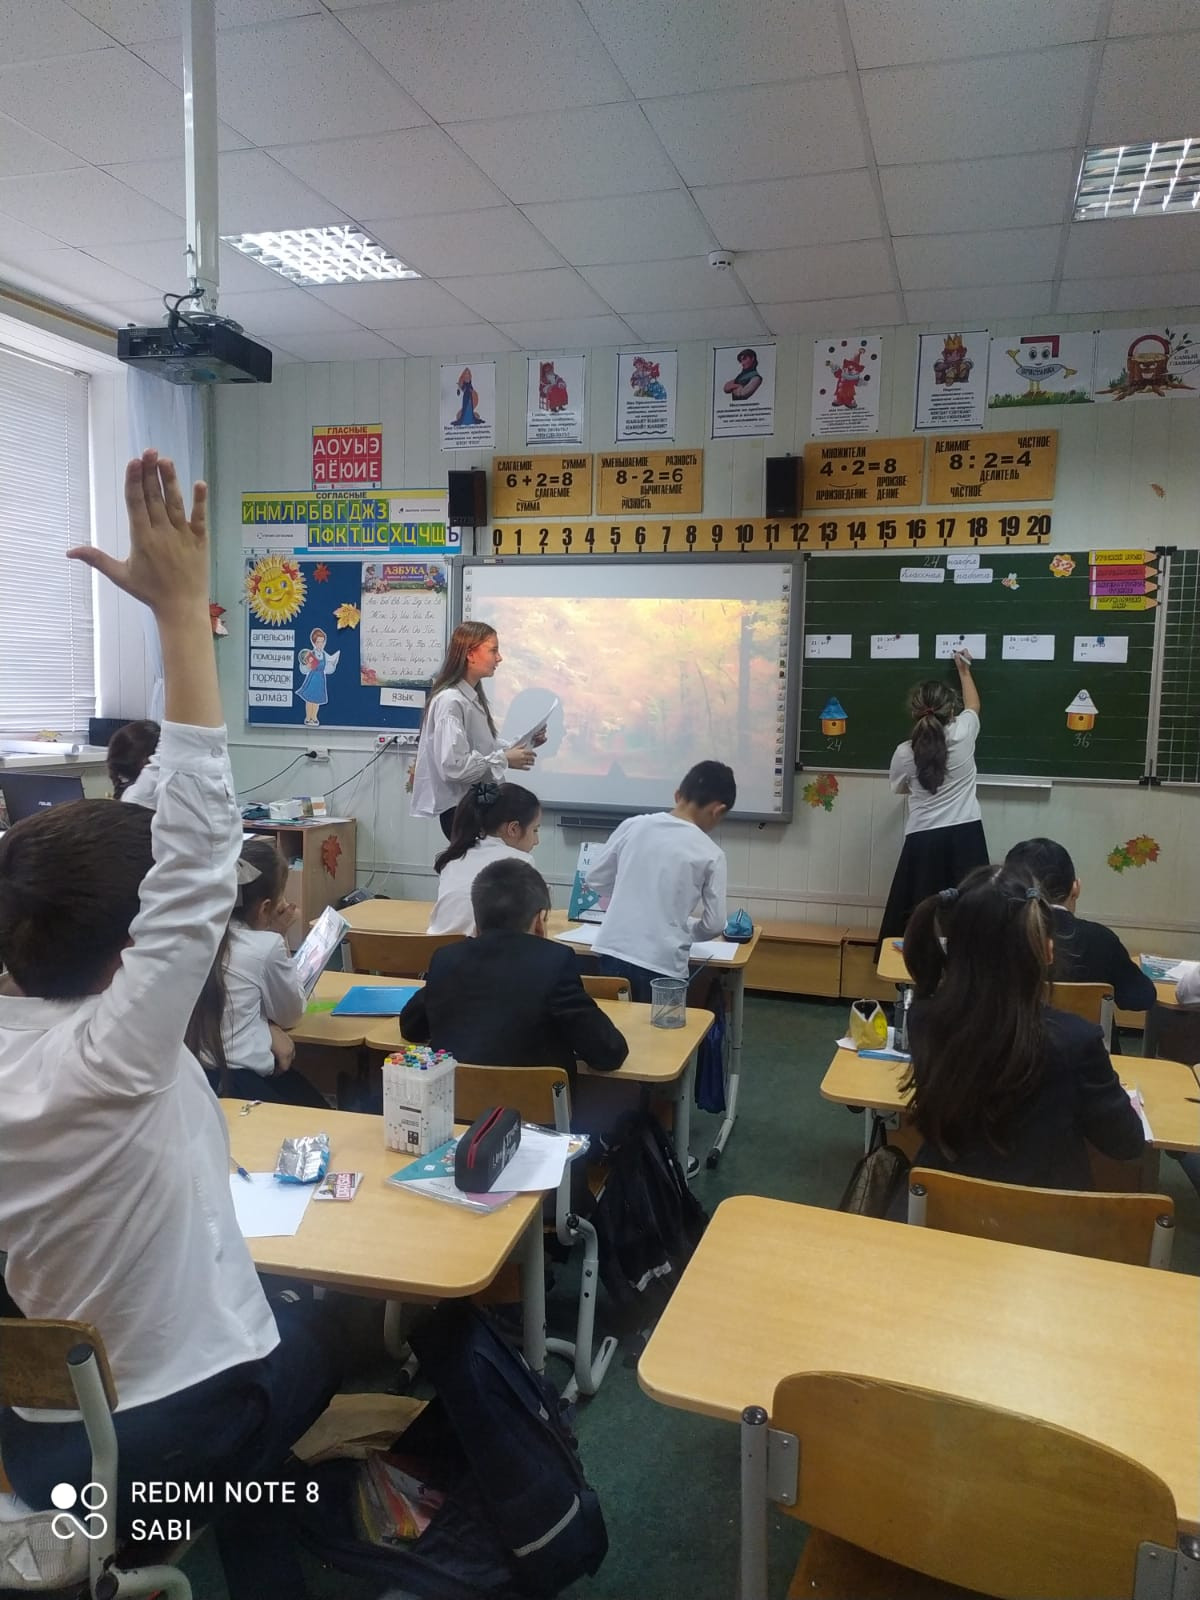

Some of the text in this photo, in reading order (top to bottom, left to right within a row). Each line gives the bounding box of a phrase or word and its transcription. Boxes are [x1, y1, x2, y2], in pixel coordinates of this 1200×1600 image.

[327, 426, 368, 435] ГЛАСНЫЕ
[935, 440, 971, 454] ДЕЛИМОЕ
[1018, 435, 1051, 449] ЧАСТНОЕ
[822, 447, 866, 459] МНОЖИТЕЛИ
[497, 461, 532, 471] СЛАГАЕМОЕ
[562, 459, 587, 469] СУММА
[601, 457, 648, 468] УМЕНЬШАЕМОЕ
[665, 455, 697, 466] РАЗНОСТЬ
[950, 454, 963, 470] 8
[506, 473, 517, 488] 6
[616, 470, 627, 484] 8
[979, 469, 1020, 482] ДЕЛИТЕЛЬ
[535, 488, 570, 498] СЛАГАЕМОЕ
[640, 484, 683, 495] ВЫЧИТАЕМОЕ
[816, 489, 868, 501] ПРОИЗВЕДЕНИЕ
[876, 488, 899, 501] ДЕНИЕ
[950, 486, 982, 498] ЧАСТНОЕ
[516, 502, 540, 512] СУММА
[621, 499, 651, 509] РАЗНОСТЬ
[493, 515, 1051, 546] 0 1 2 3 4 5 6 7 8 9 10 11 12 13 14 15 16 17 18 19 20
[384, 566, 425, 575] АЗБУКА
[252, 633, 294, 641] апельсин
[253, 653, 292, 661] помощник
[252, 673, 290, 684] порядок
[255, 693, 288, 702] алмаз
[391, 693, 415, 702] язык
